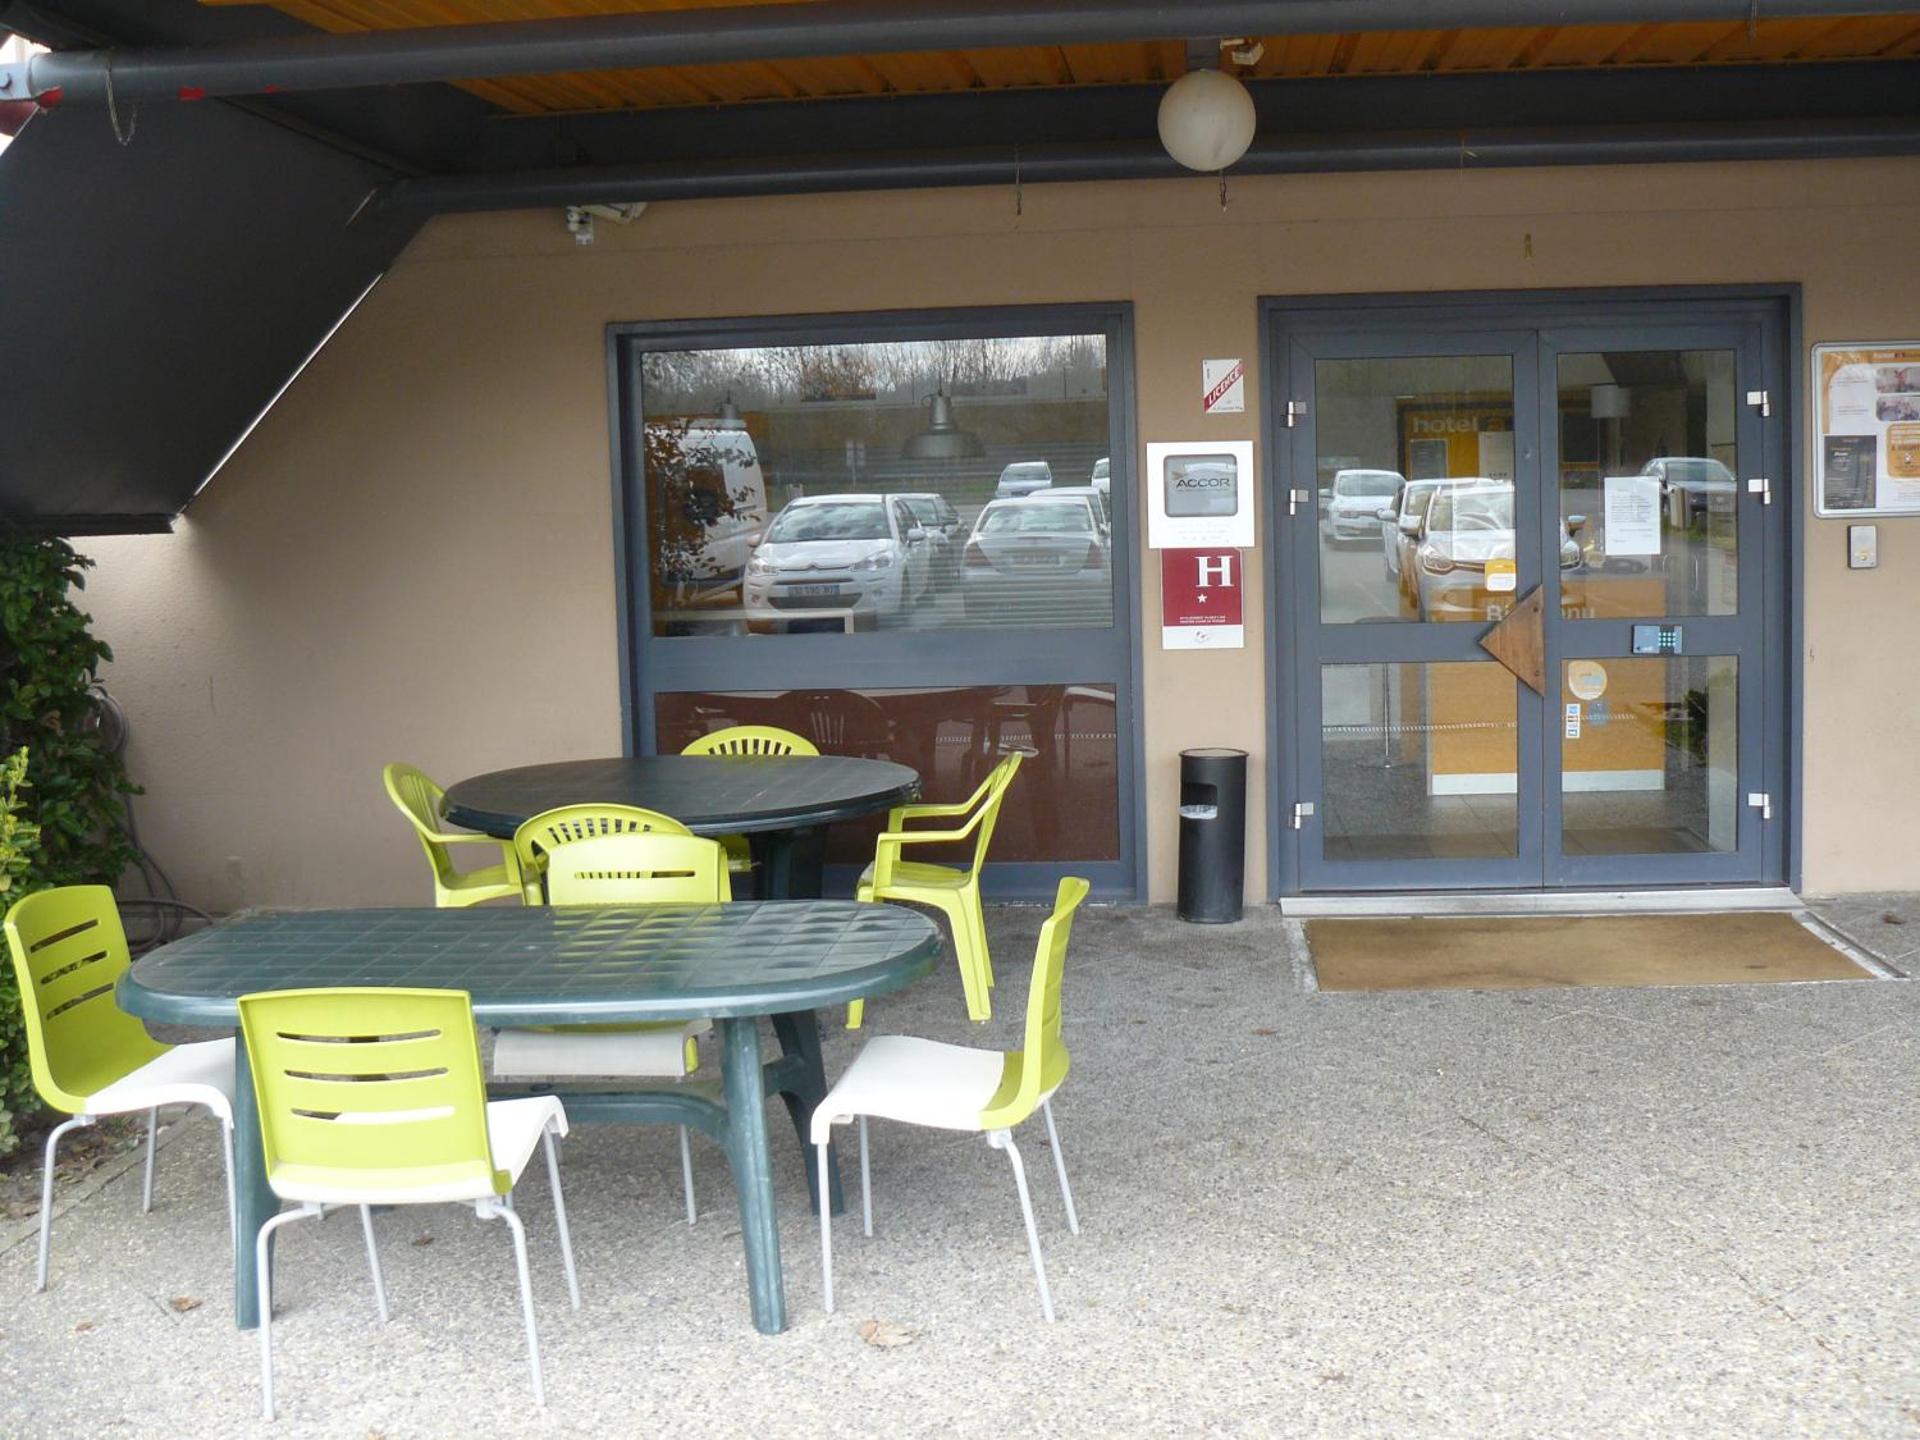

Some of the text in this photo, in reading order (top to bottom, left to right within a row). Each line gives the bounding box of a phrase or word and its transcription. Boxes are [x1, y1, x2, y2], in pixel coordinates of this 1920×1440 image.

[1208, 365, 1243, 405] LICENCE
[1413, 416, 1478, 432] hotel
[1176, 478, 1230, 488] ACCOR
[1194, 555, 1234, 587] H
